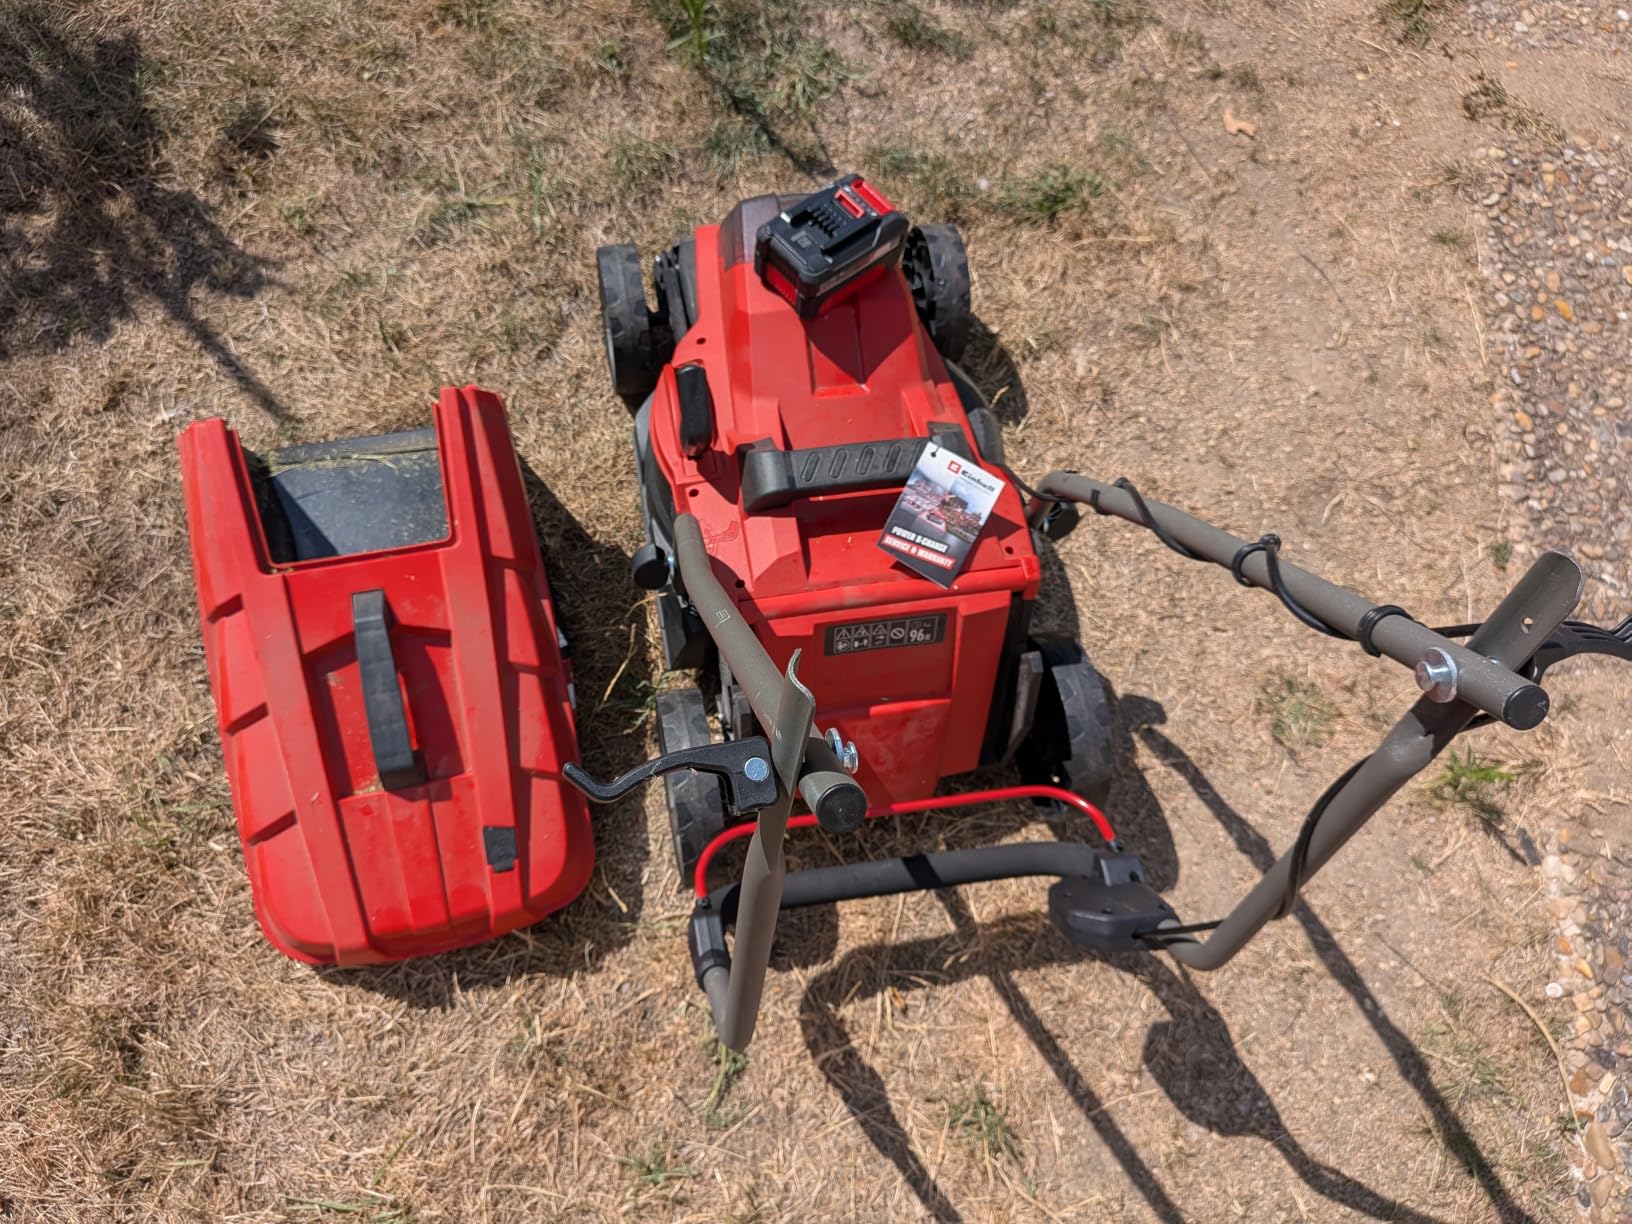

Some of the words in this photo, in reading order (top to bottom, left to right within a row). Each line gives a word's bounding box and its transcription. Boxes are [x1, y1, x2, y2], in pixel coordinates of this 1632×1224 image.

[960, 470, 996, 491] Einhell
[892, 526, 915, 542] POWER
[884, 536, 911, 552] SERVICE
[917, 548, 954, 567] WARRANTY
[909, 629, 925, 642] 96
